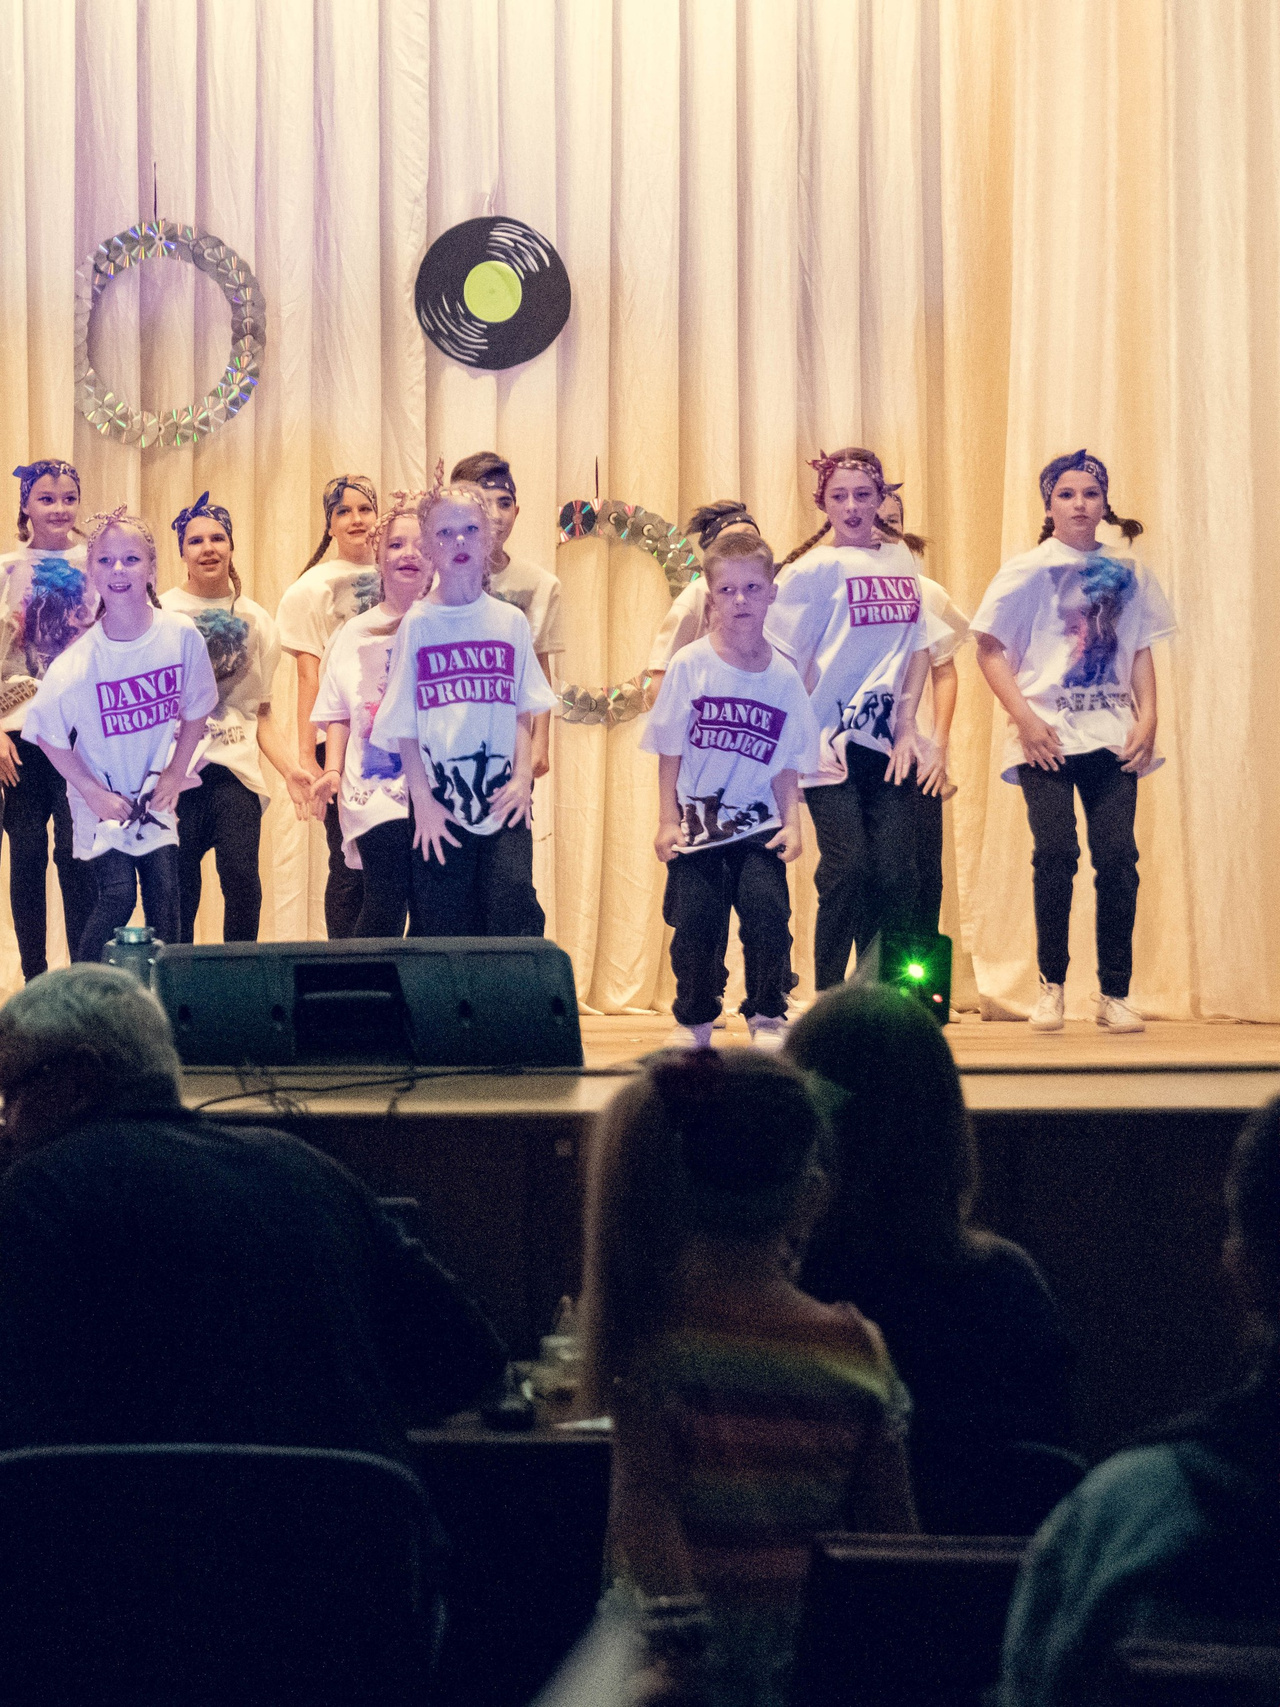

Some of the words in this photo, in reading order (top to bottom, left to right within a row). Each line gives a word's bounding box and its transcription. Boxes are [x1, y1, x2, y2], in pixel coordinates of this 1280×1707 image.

[427, 647, 506, 674] DANCE
[420, 679, 515, 707] PROJECT
[701, 701, 771, 732] DANCE
[690, 723, 772, 760] PROJECT
